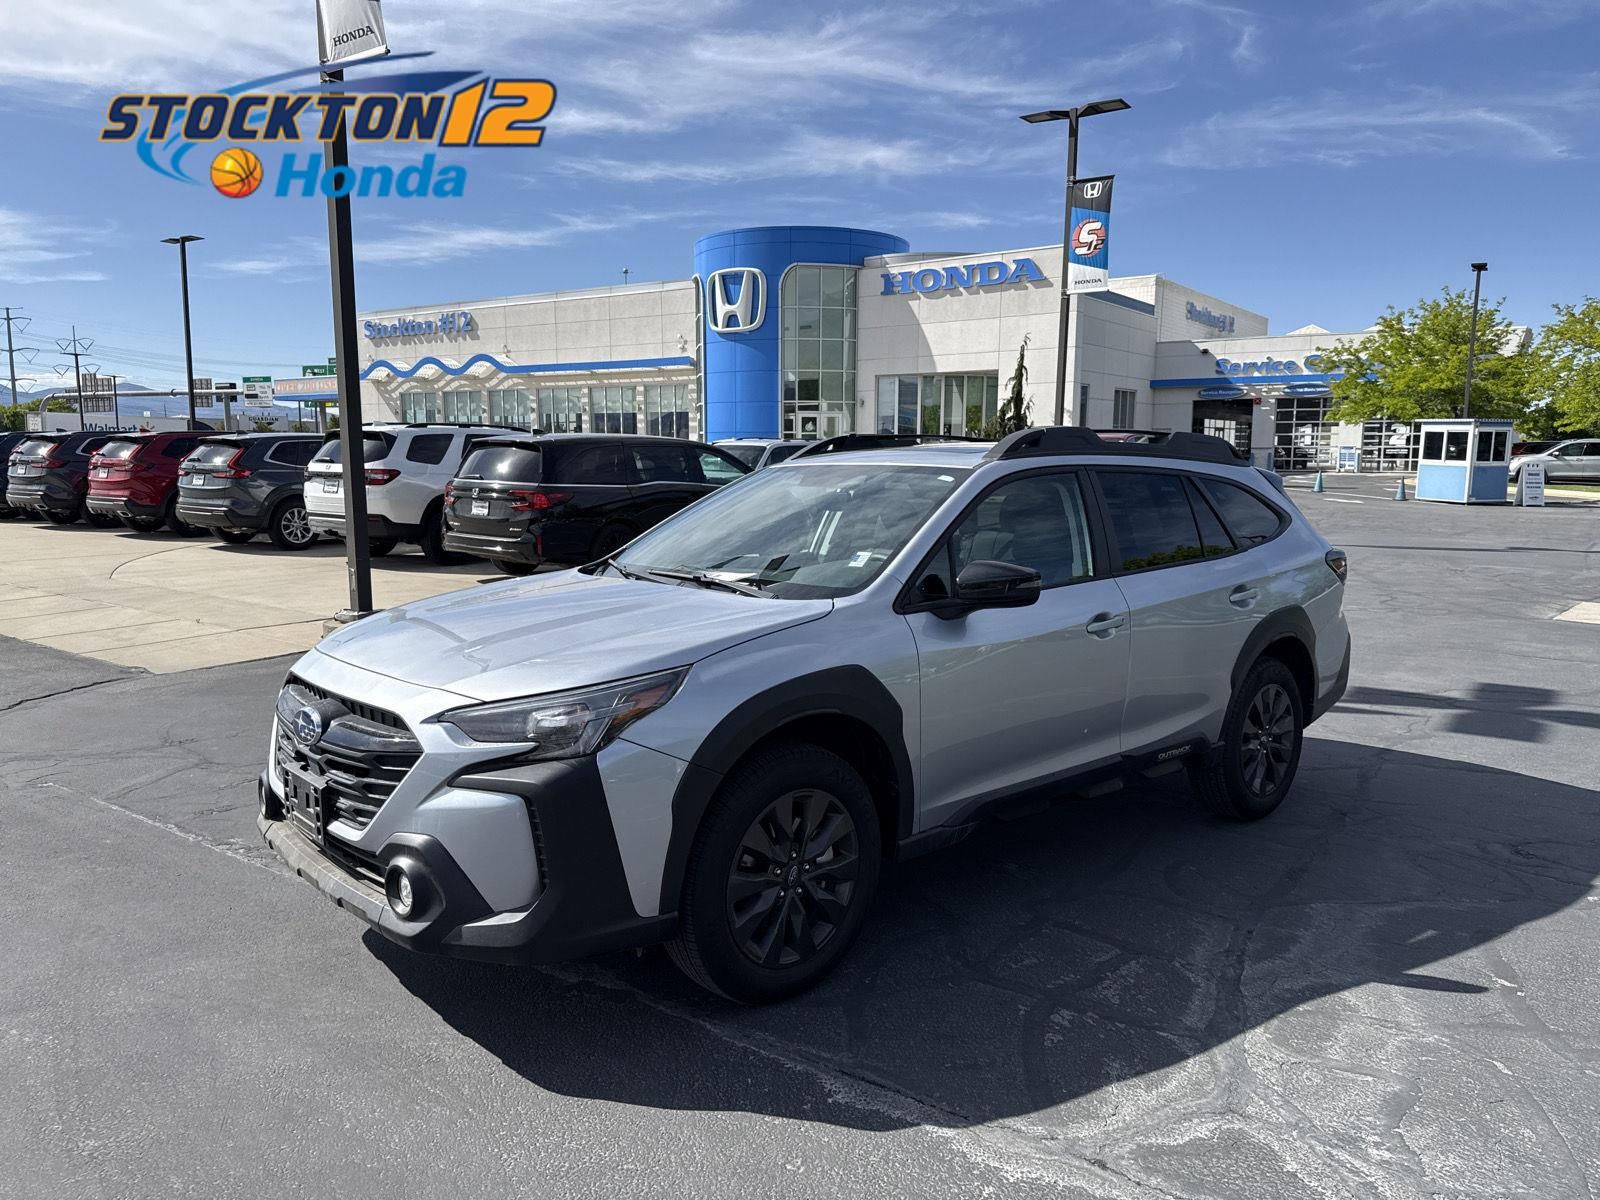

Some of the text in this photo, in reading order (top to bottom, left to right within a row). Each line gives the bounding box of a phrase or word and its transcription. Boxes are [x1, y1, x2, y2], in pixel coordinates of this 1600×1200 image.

[333, 25, 375, 48] HONDA
[880, 258, 1046, 296] HONDA
[364, 310, 472, 338] Stockton #12
[1216, 356, 1298, 376] Service
[1389, 423, 1410, 446] 2
[1158, 744, 1192, 760] OUTBACK
